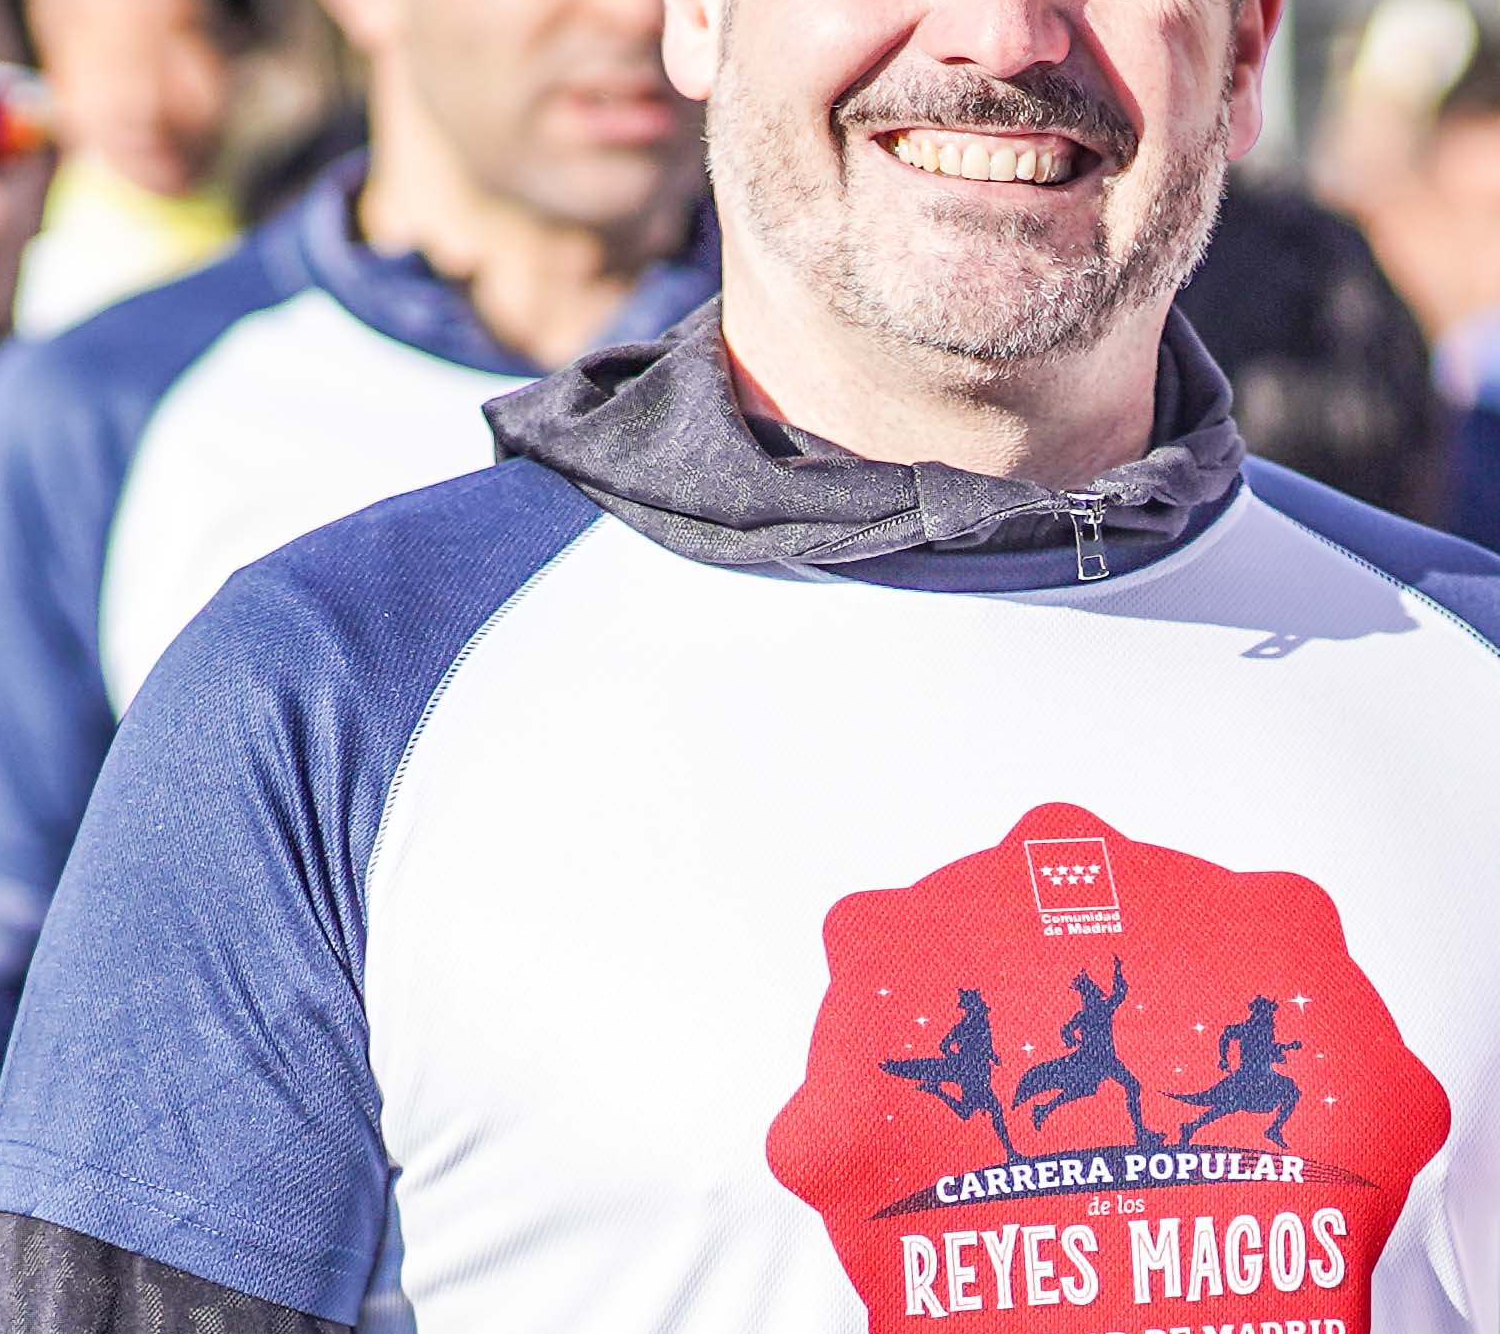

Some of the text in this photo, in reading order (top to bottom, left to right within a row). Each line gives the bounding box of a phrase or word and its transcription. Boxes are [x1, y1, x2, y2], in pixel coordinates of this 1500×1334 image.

[1041, 911, 1121, 924] Comunidad
[1043, 921, 1123, 936] de Madrid
[936, 1151, 1304, 1204] CARRERA POPULAR
[1087, 1195, 1145, 1216] de los
[900, 1207, 1349, 1319] REYES MAGOS
